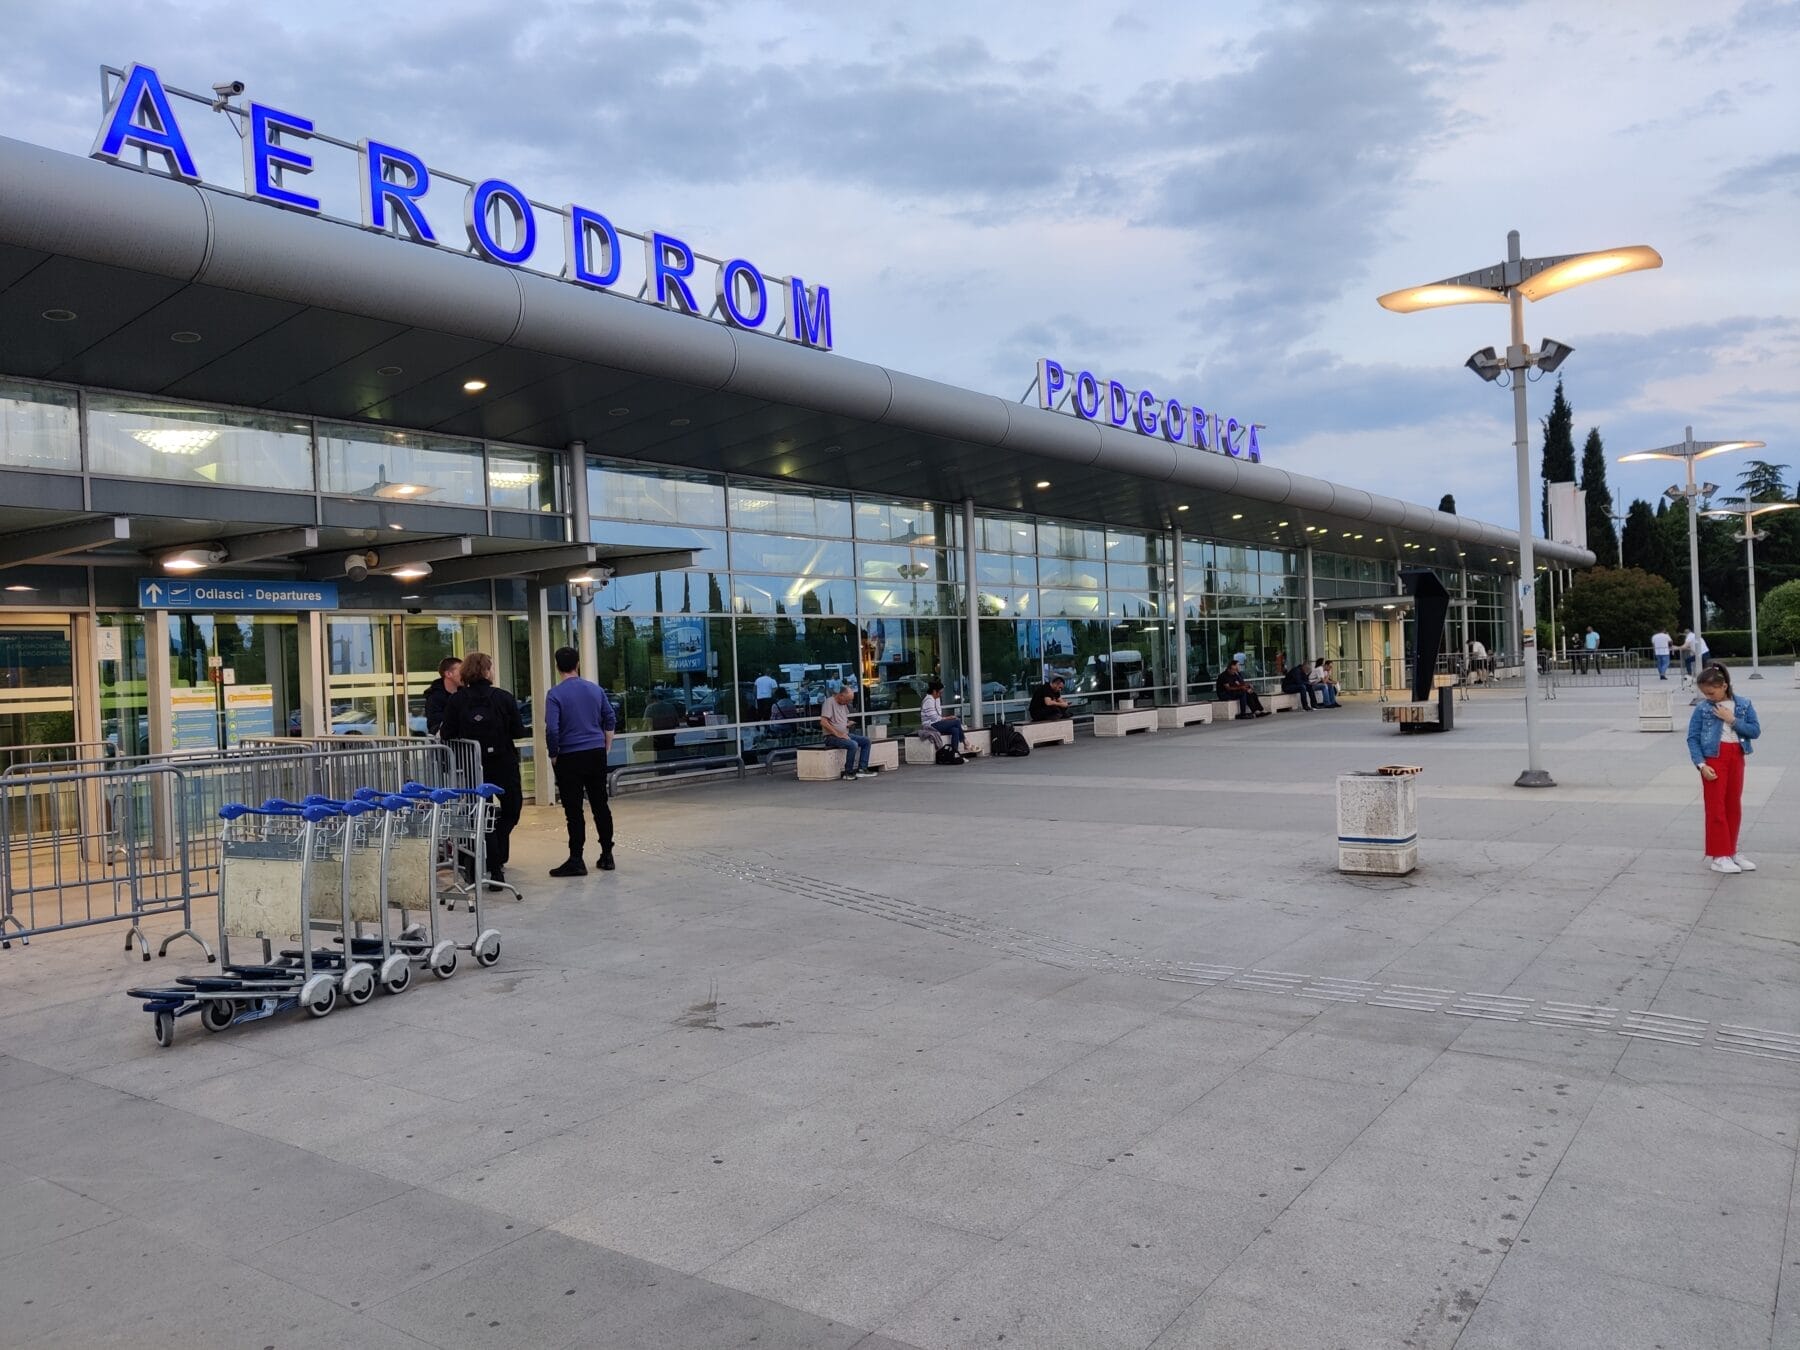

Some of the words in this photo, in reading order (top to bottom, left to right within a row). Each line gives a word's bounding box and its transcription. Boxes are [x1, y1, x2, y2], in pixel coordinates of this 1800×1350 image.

[91, 61, 833, 351] AERODROM
[1037, 358, 1262, 464] PODGORICA
[195, 587, 244, 600] Odlasci
[255, 588, 322, 603] Departures
